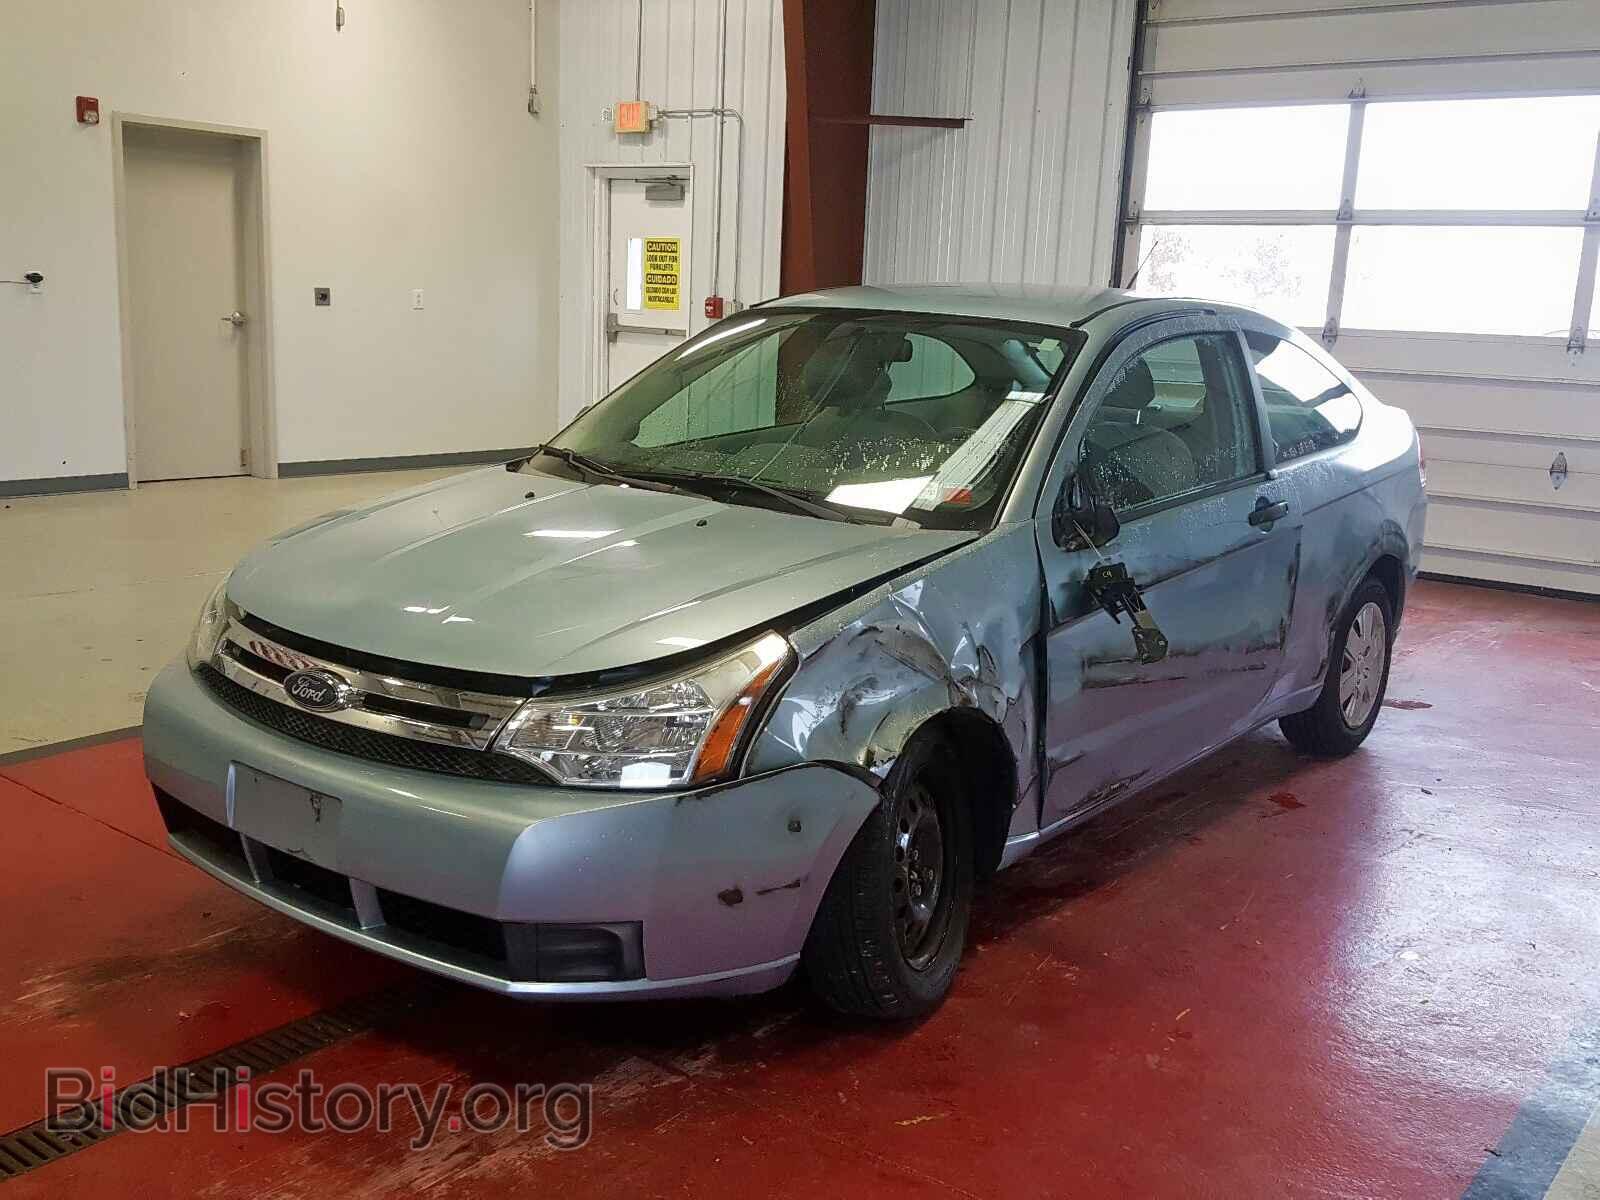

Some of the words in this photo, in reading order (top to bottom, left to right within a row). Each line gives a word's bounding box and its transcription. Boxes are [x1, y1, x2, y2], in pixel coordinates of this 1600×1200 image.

[647, 242, 677, 252] CAUTION
[647, 274, 677, 284] CUIDADO
[292, 676, 327, 702] Ford
